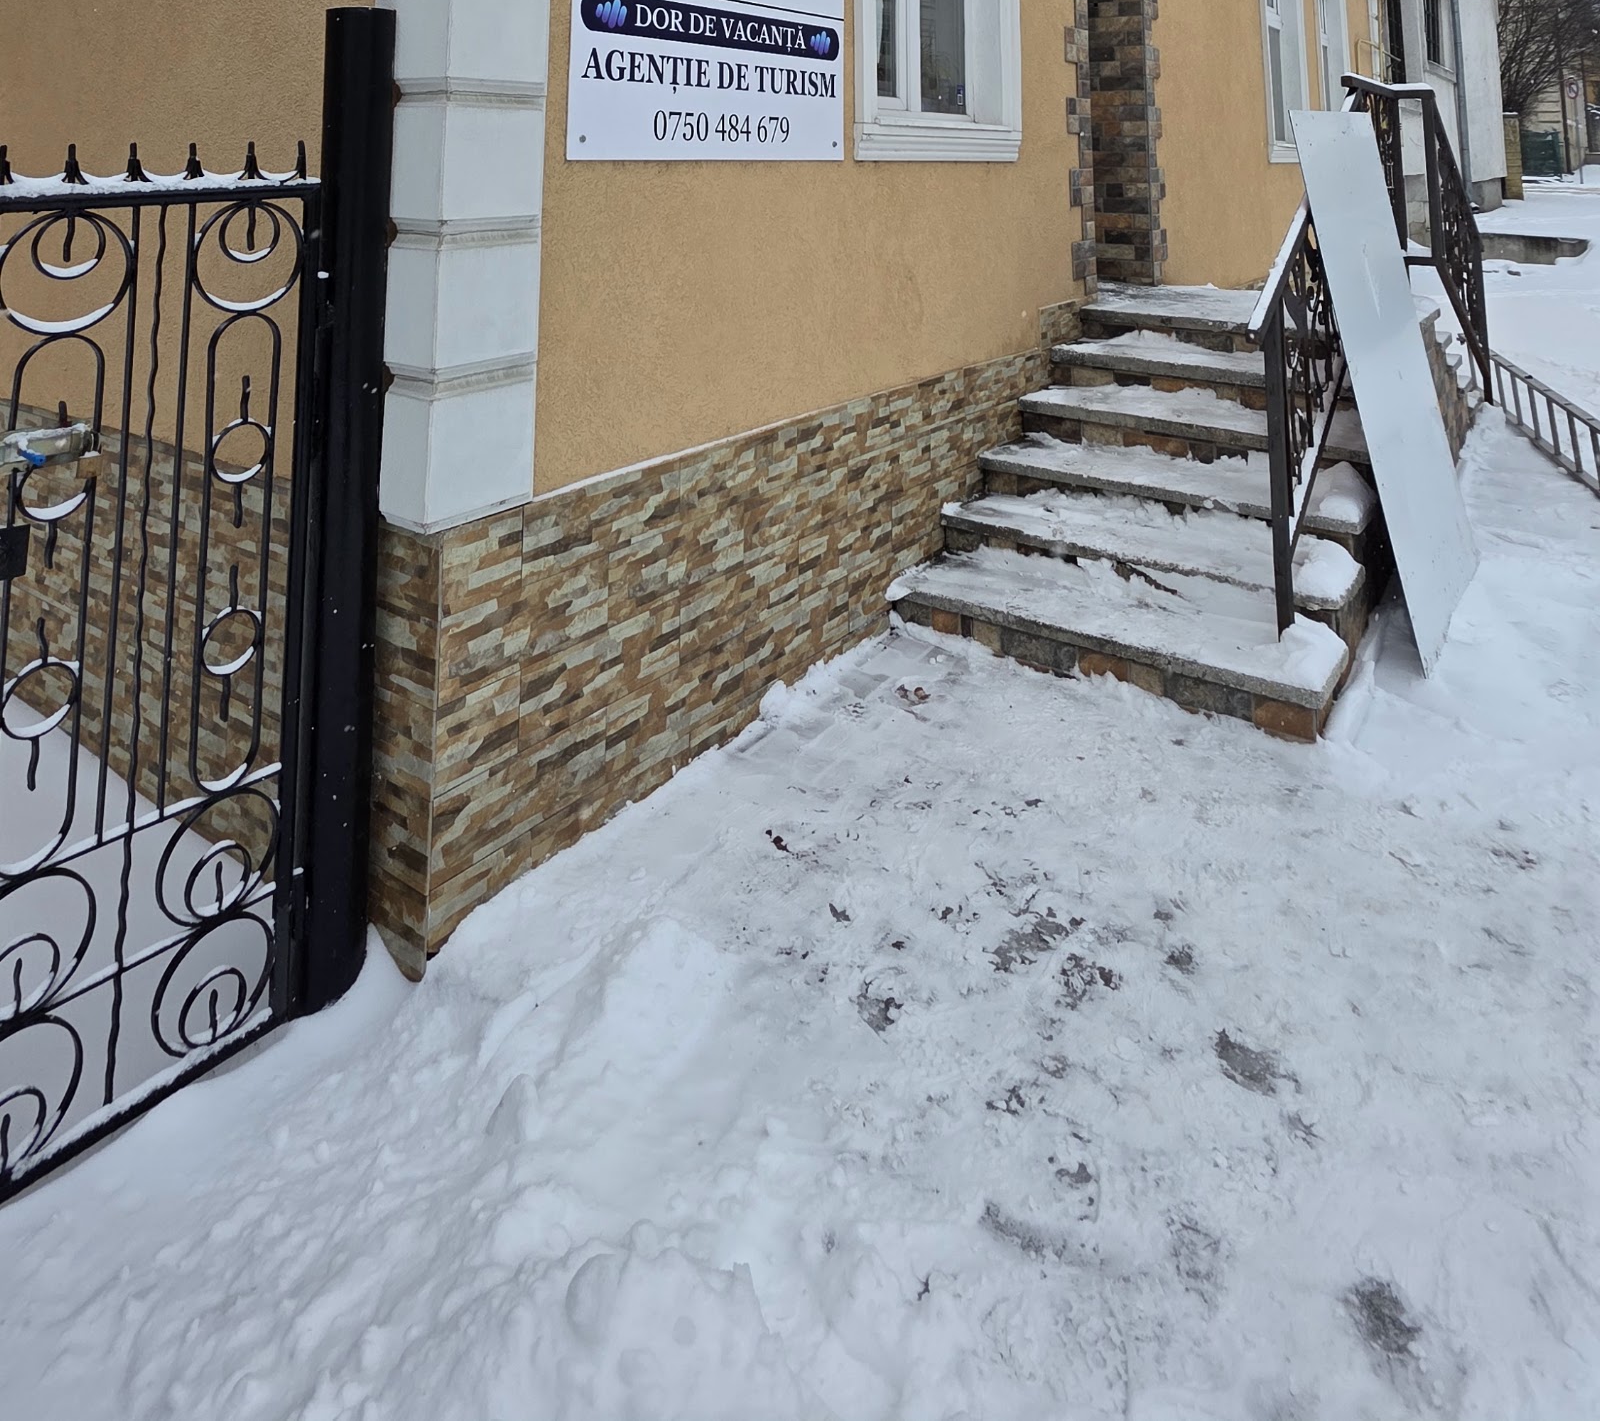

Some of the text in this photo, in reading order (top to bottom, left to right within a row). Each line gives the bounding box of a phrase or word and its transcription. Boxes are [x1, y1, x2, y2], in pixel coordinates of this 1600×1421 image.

[634, 3, 807, 53] DOR DE VACANȚĂ
[581, 47, 837, 99] AGENȚIE DE TURISM
[653, 109, 790, 143] 0750 484 679
